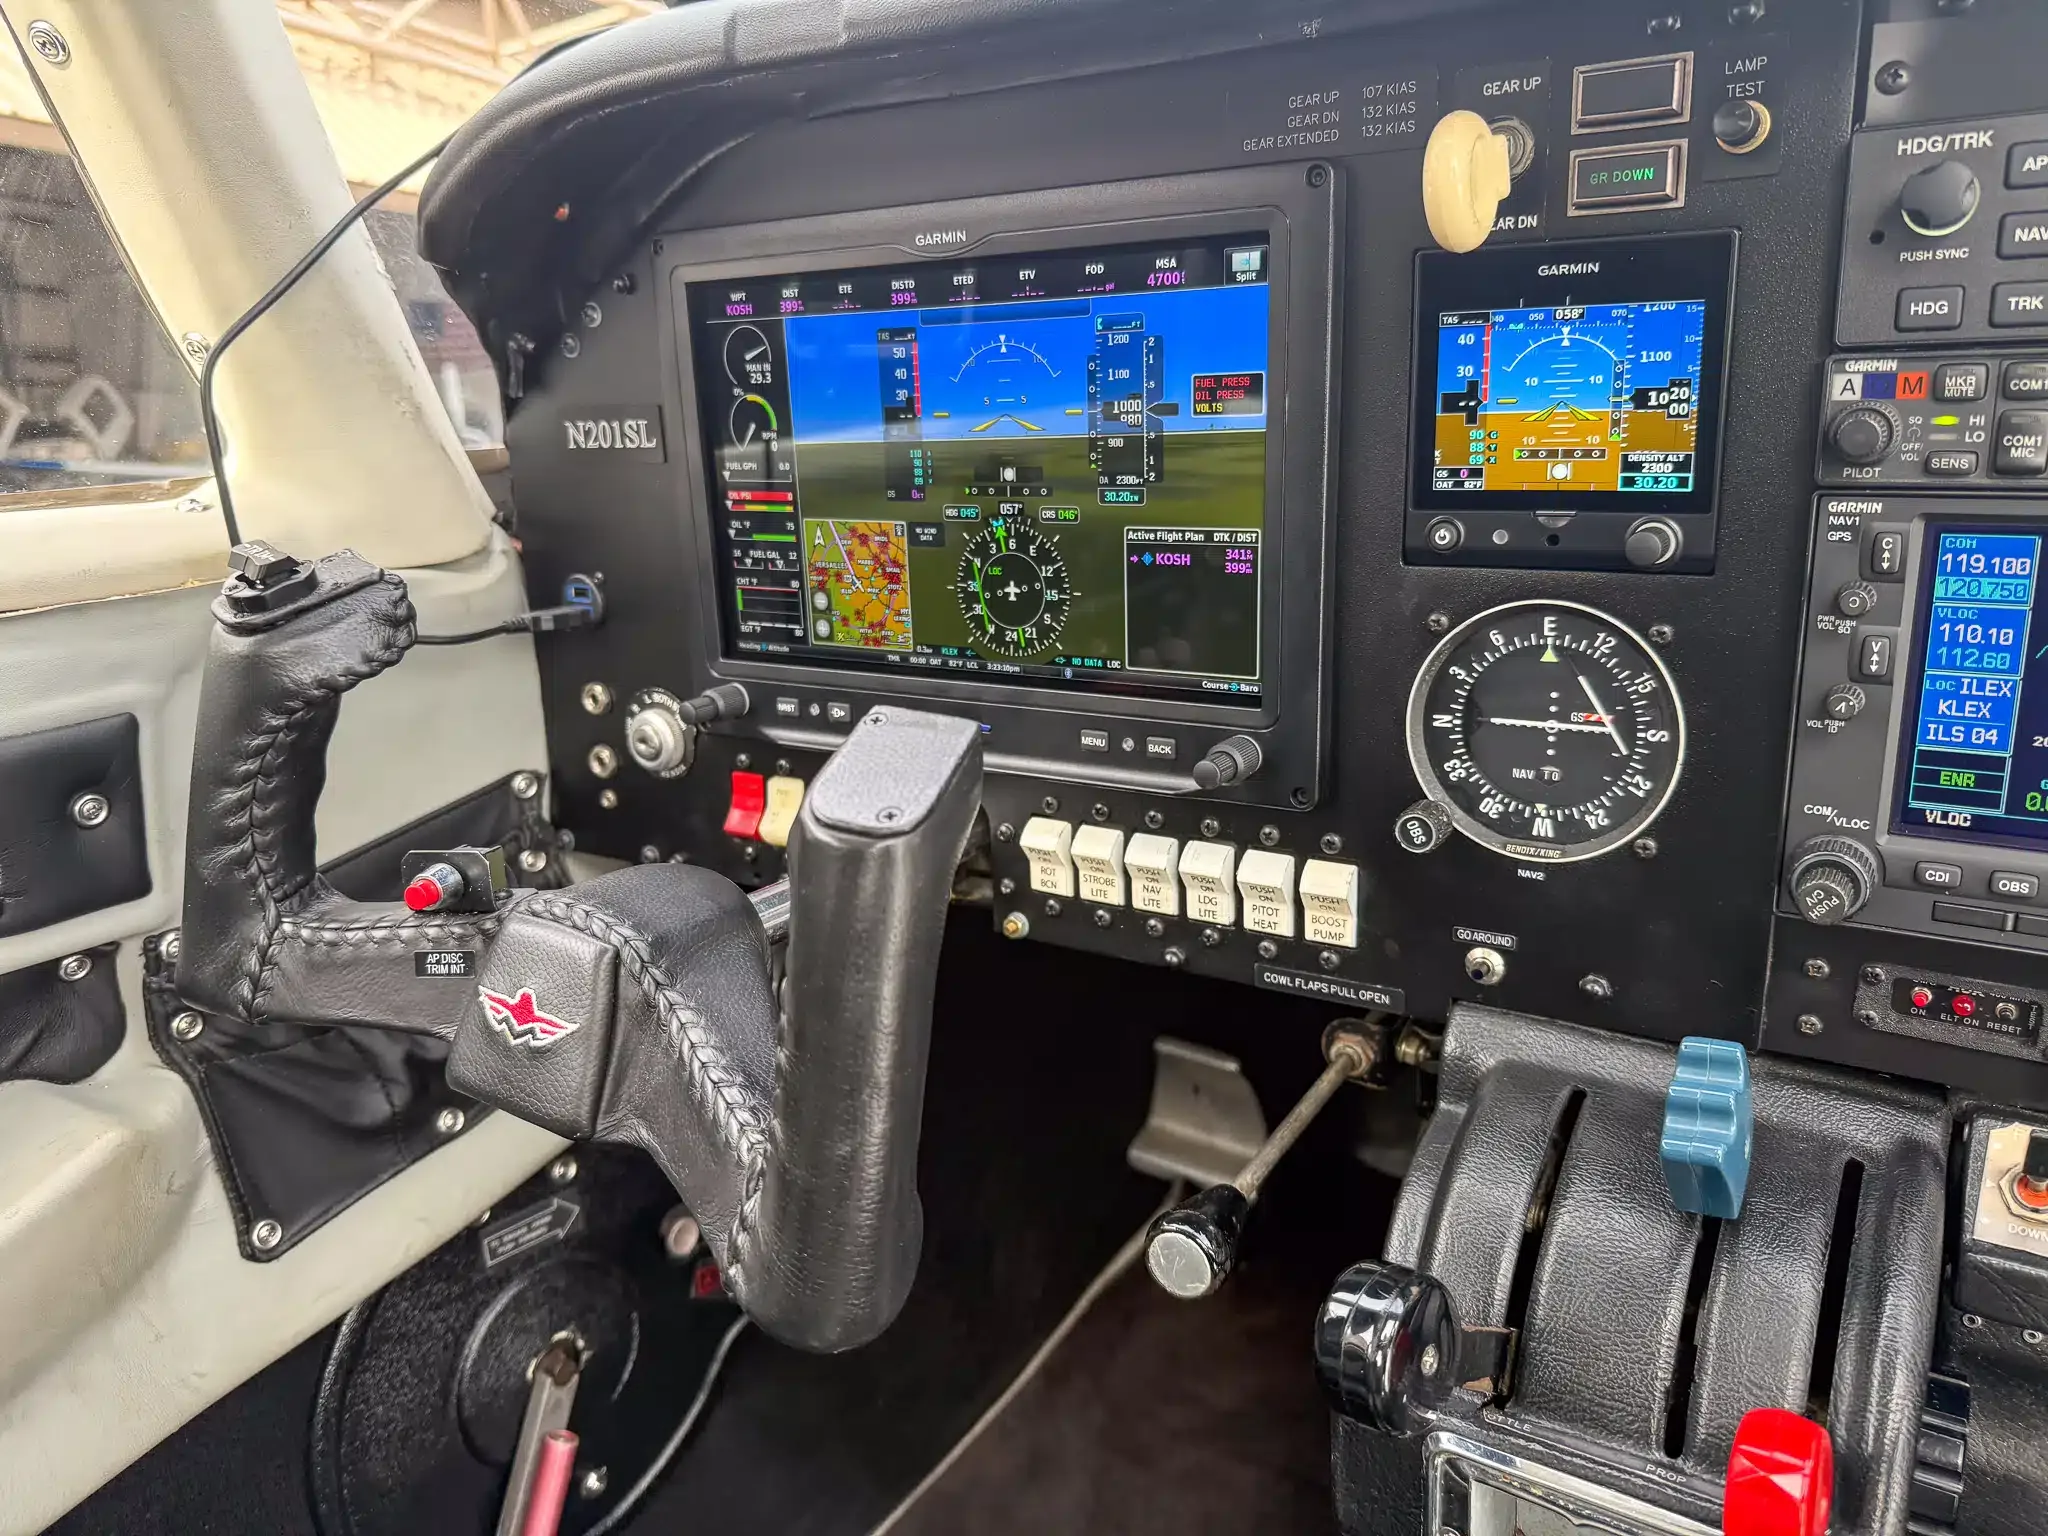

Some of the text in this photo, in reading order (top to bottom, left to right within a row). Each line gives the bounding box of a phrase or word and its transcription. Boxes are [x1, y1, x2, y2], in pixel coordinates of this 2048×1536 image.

[1725, 56, 1768, 75] LAMP
[1483, 77, 1541, 96] GEAR UP
[1727, 81, 1765, 98] TEST
[1289, 81, 1416, 109] GEAR UP 107 KIAS
[1287, 102, 1416, 128] GEAR DN 132 KIAS
[1243, 121, 1415, 151] GEAR EXTENDED 132 KIAS
[1897, 130, 1994, 156] HDG/TRK
[1590, 168, 1654, 185] GR DOWN
[1490, 214, 1537, 231] AR DN
[915, 230, 967, 246] GARMIN
[1900, 248, 1969, 262] PUSH SYNC
[1156, 258, 1177, 269] MSA
[1538, 262, 1600, 276] GARMIN
[1019, 270, 1036, 280] ETV
[1086, 264, 1104, 275] FOD
[953, 276, 974, 286] ETED
[1236, 272, 1256, 282] Split
[838, 285, 852, 294] ETE
[891, 281, 915, 289] DISTD
[730, 293, 746, 302] WPT
[782, 288, 798, 298] DIST
[1910, 302, 1948, 316] HDG
[2008, 296, 2043, 311] TRK
[726, 304, 752, 316] KOSH
[1442, 316, 1459, 324] TAS
[1528, 313, 1544, 321] 050
[1107, 334, 1129, 346] 1200
[1457, 334, 1475, 345] 40
[893, 348, 906, 358] 50
[1640, 351, 1672, 362] 1100
[1845, 359, 1898, 372] GARMIN
[894, 369, 907, 379] 40
[1108, 368, 1129, 380] 1100
[1456, 366, 1473, 377] 30
[751, 373, 772, 383] 29.3
[1196, 377, 1250, 388] FUEL PRESS
[1945, 376, 1976, 387] MKR
[1840, 379, 1856, 396] A
[1902, 376, 1924, 394] M
[1196, 390, 1244, 400] OIL PRESS
[1944, 388, 1974, 397] MUTE
[1196, 404, 1223, 412] VOLTS
[1908, 416, 1922, 425] SQ
[1969, 415, 1984, 426] HI
[564, 419, 657, 449] N201SL
[1470, 430, 1484, 440] 90
[1965, 431, 1984, 442] LO
[2003, 435, 2042, 447] COM1
[1900, 453, 1919, 461] VOL
[2010, 447, 2035, 457] MIC
[1641, 463, 1673, 473] 2300
[1931, 459, 1969, 469] SENS
[1436, 470, 1448, 478] GS
[1843, 468, 1881, 478] PILOT
[1634, 477, 1678, 488] 30.20
[1828, 502, 1882, 514] GARMIN
[1042, 511, 1055, 519] CRS
[1828, 516, 1860, 526] NAV1
[1128, 531, 1257, 542] Active Flight Plan DTK DIST
[1828, 532, 1852, 542] GPS
[1882, 538, 1893, 550] C
[1946, 538, 1976, 549] COM
[1156, 553, 1191, 566] KOSH
[1942, 553, 2031, 576] 119.100
[1938, 578, 2028, 599] 120.750
[1937, 608, 1979, 620] VLOC
[1544, 616, 1557, 636] E
[1817, 622, 1834, 630] VOL
[1939, 623, 2013, 645] 110.10
[1593, 632, 1616, 654] 12
[1937, 646, 2010, 669] 112.60
[1085, 659, 1121, 669] DATA LOC
[1202, 681, 1258, 692] Course Baro
[1925, 678, 2013, 698] LOC ILEX
[1938, 699, 1992, 719] KLEX
[1570, 712, 1584, 723] GS
[1806, 720, 1823, 728] VOL
[1926, 724, 1998, 746] ILS 04
[1082, 736, 1105, 747] MENU
[1149, 744, 1172, 754] BACK
[1512, 768, 1534, 779] NAV
[1940, 771, 1975, 788] ENR
[1925, 810, 1972, 827] VLOC
[1406, 820, 1427, 845] OBS
[1506, 844, 1562, 858] BENDIX/KING
[1041, 866, 1056, 876] ROT
[1517, 869, 1544, 881] NAV2
[1925, 870, 1949, 882] CDI
[1041, 879, 1057, 889] BCN
[1083, 874, 1116, 887] STROBE
[1143, 885, 1161, 896] NAV
[1249, 885, 1275, 895] PUSH
[1998, 880, 2029, 893] OBS
[1091, 888, 1108, 898] LITE
[1143, 898, 1161, 909] LITE
[1198, 895, 1218, 906] LDG
[1310, 895, 1340, 905] PUSH
[1252, 904, 1280, 917] PITOT
[1808, 896, 1840, 919] PUSH
[1199, 908, 1217, 919] LITE
[1253, 919, 1278, 931] HEAT
[1311, 914, 1347, 928] BOOST
[1314, 929, 1345, 942] PUMP
[1457, 929, 1511, 947] GO AROUND
[427, 953, 463, 964] AP DISC
[426, 964, 465, 974] TRIM INT
[1264, 972, 1389, 1005] COWL FLAPS PULL OPEN
[1910, 1007, 1926, 1016] ON
[2028, 1005, 2038, 1029] TEST
[1940, 1013, 1979, 1026] ELT ON
[1987, 1022, 2021, 1035] RESET
[1646, 1464, 1687, 1484] PROP
